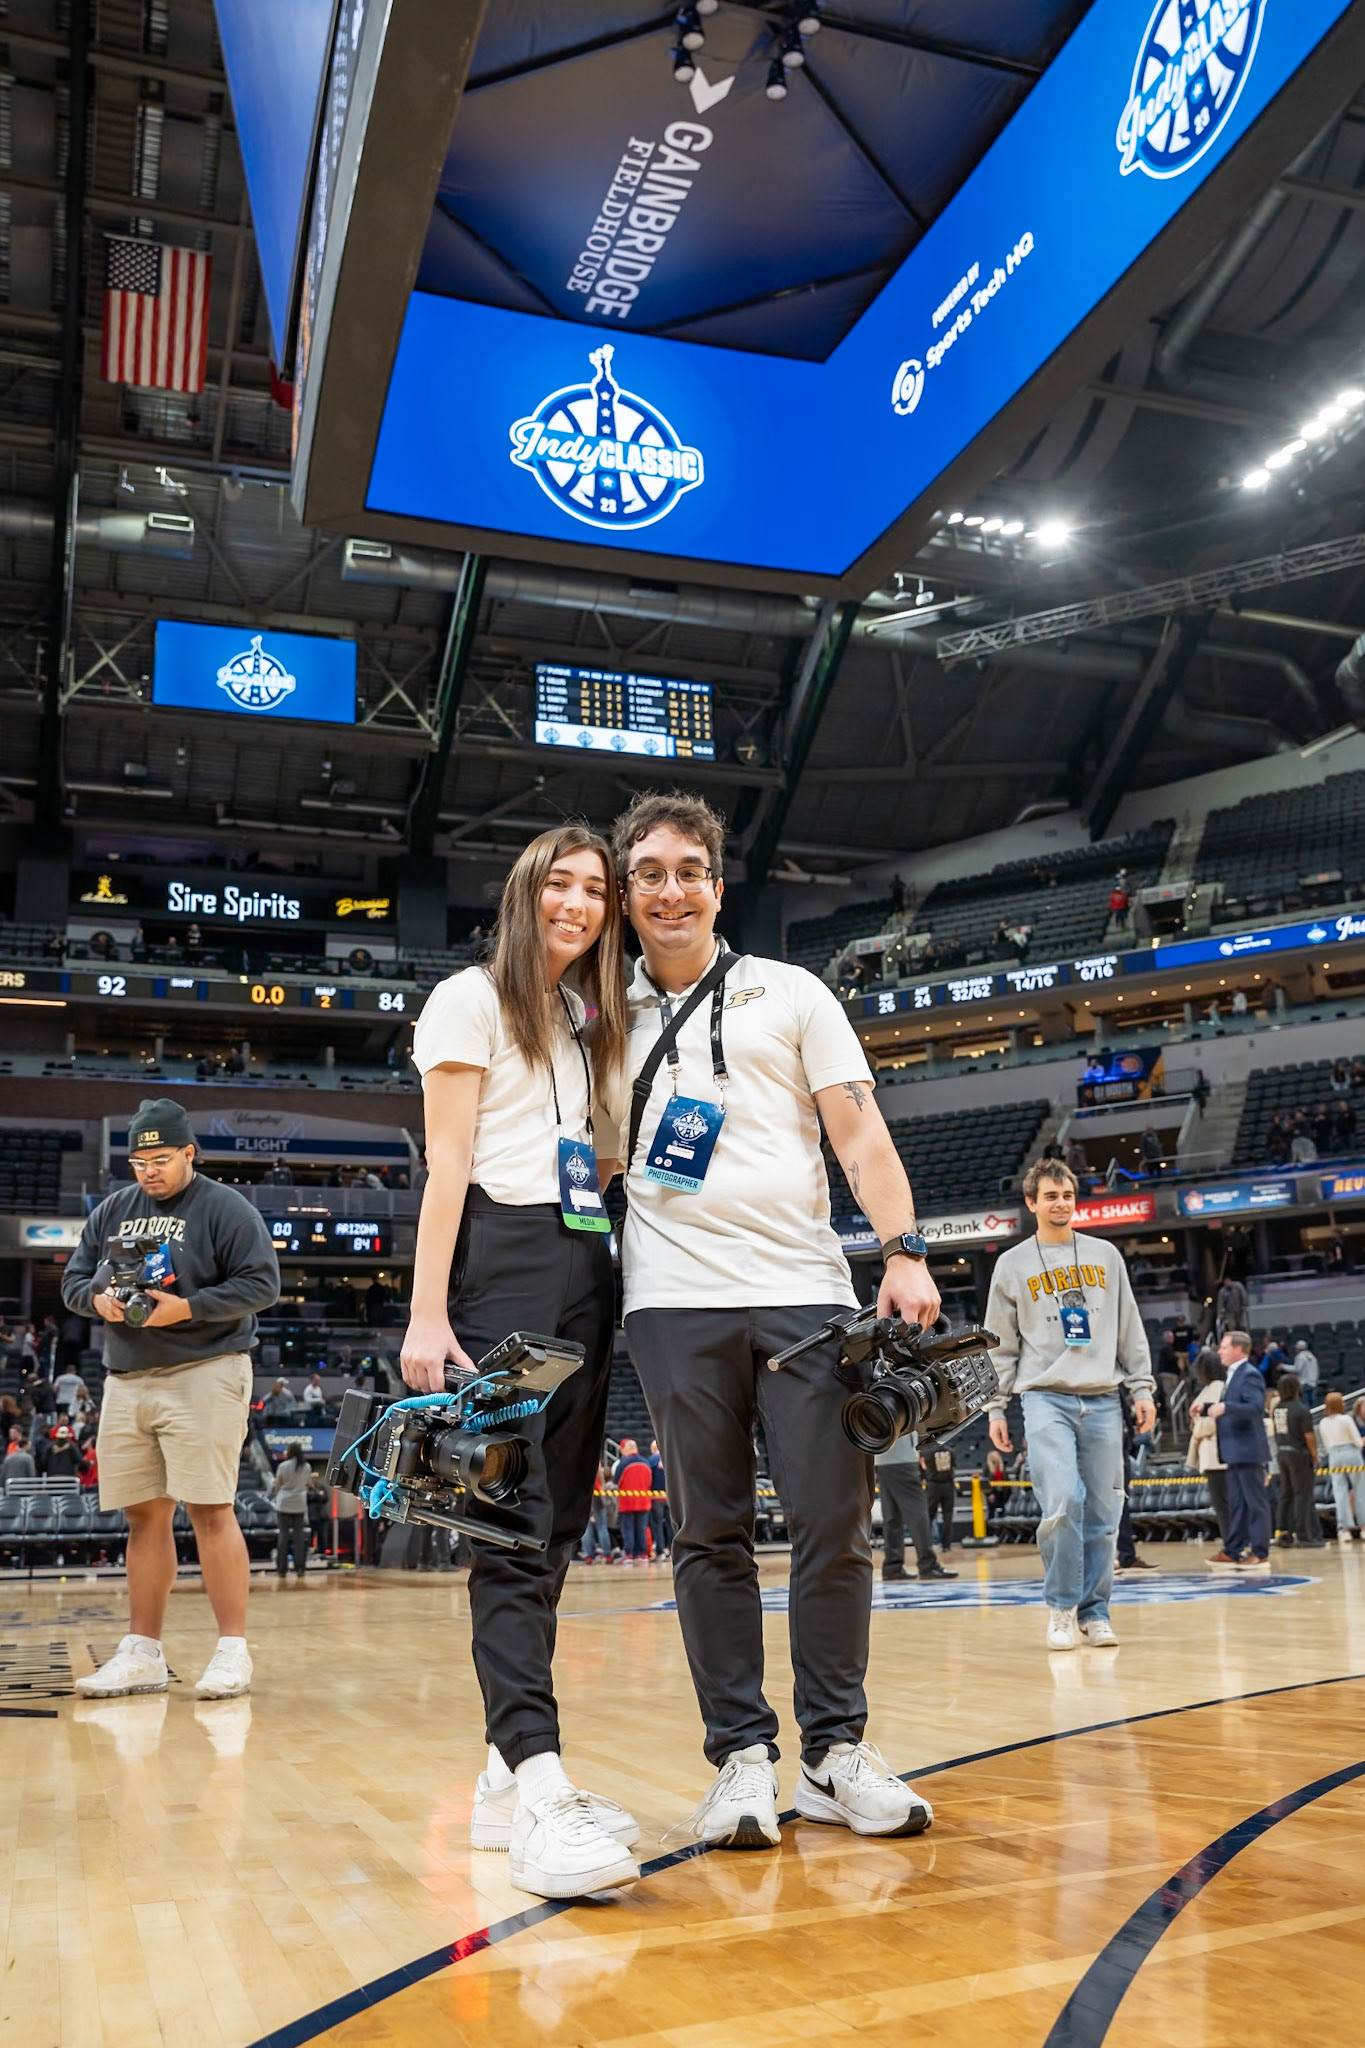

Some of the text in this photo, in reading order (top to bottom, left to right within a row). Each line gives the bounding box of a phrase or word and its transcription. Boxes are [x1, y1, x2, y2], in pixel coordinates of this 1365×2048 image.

[566, 136, 655, 293] FIELDHOUSE
[585, 121, 713, 319] GAINBRIDGE
[926, 232, 1034, 369] Sports Tech HQ
[600, 498, 617, 514] 23
[168, 882, 299, 921] Sire Spirits
[1080, 964, 1114, 981] 6/16
[98, 975, 126, 996] 92
[171, 978, 194, 988] SHOT
[1014, 974, 1053, 992] 14/16
[251, 984, 285, 1005] 0.0
[378, 992, 405, 1012] 84
[914, 994, 932, 1008] 24
[952, 984, 991, 1002] 32/62
[320, 996, 331, 1009] 2
[879, 1000, 896, 1014] 26
[235, 1138, 290, 1151] FLIGHT
[648, 1168, 699, 1189] PHOTOGRAPHER
[1102, 1201, 1150, 1219] SHAKE
[335, 1222, 379, 1236] ARIZONA
[579, 1217, 596, 1226] MEDIA
[917, 1221, 981, 1238] KeyBank
[1027, 1264, 1106, 1302] PURDUE
